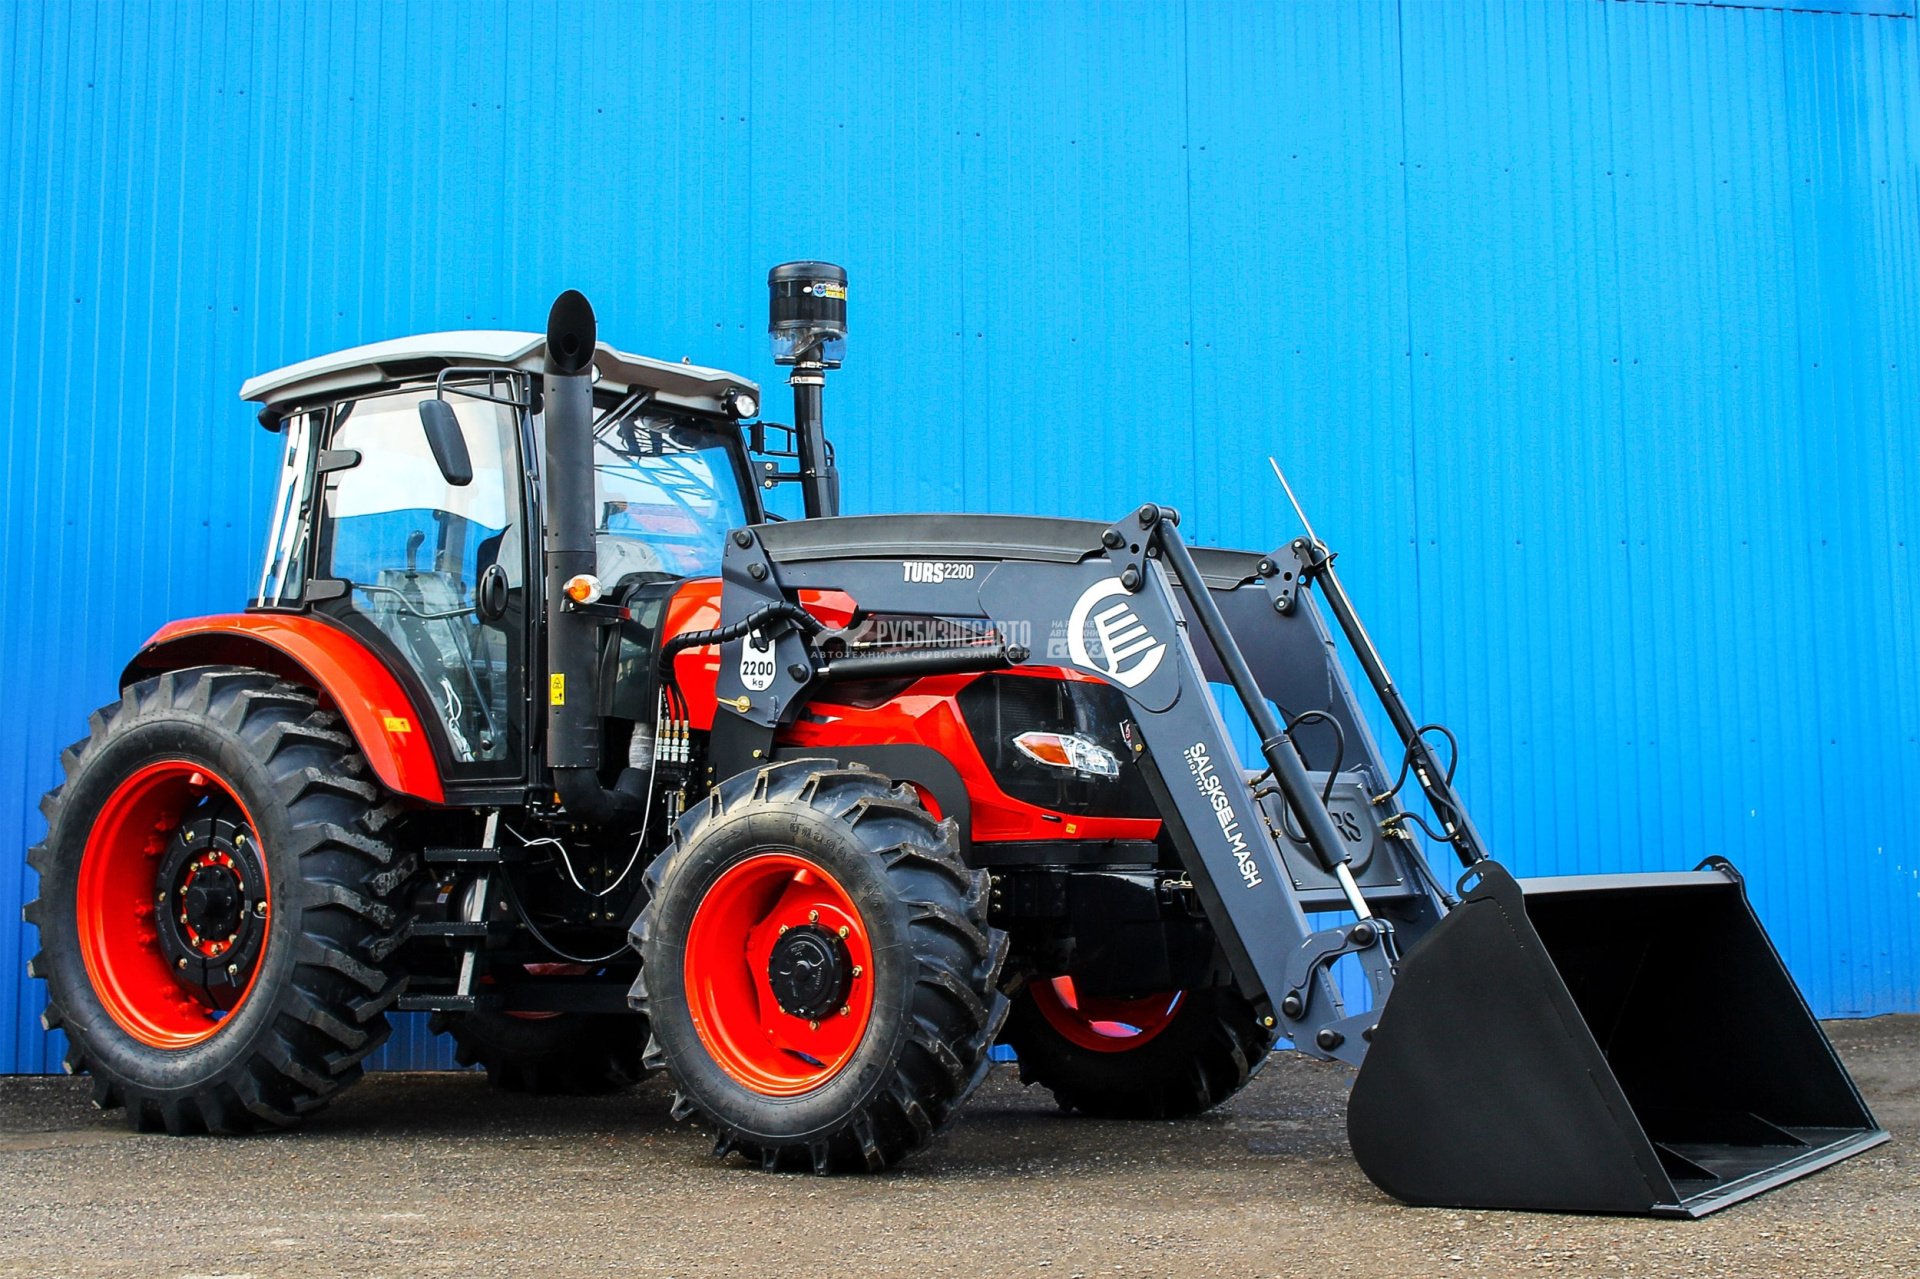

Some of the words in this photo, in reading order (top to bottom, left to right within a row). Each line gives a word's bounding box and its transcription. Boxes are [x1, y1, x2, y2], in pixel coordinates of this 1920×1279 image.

[742, 661, 774, 676] 2200
[752, 678, 764, 688] kg
[1190, 742, 1263, 888] SALSKSELMASH
